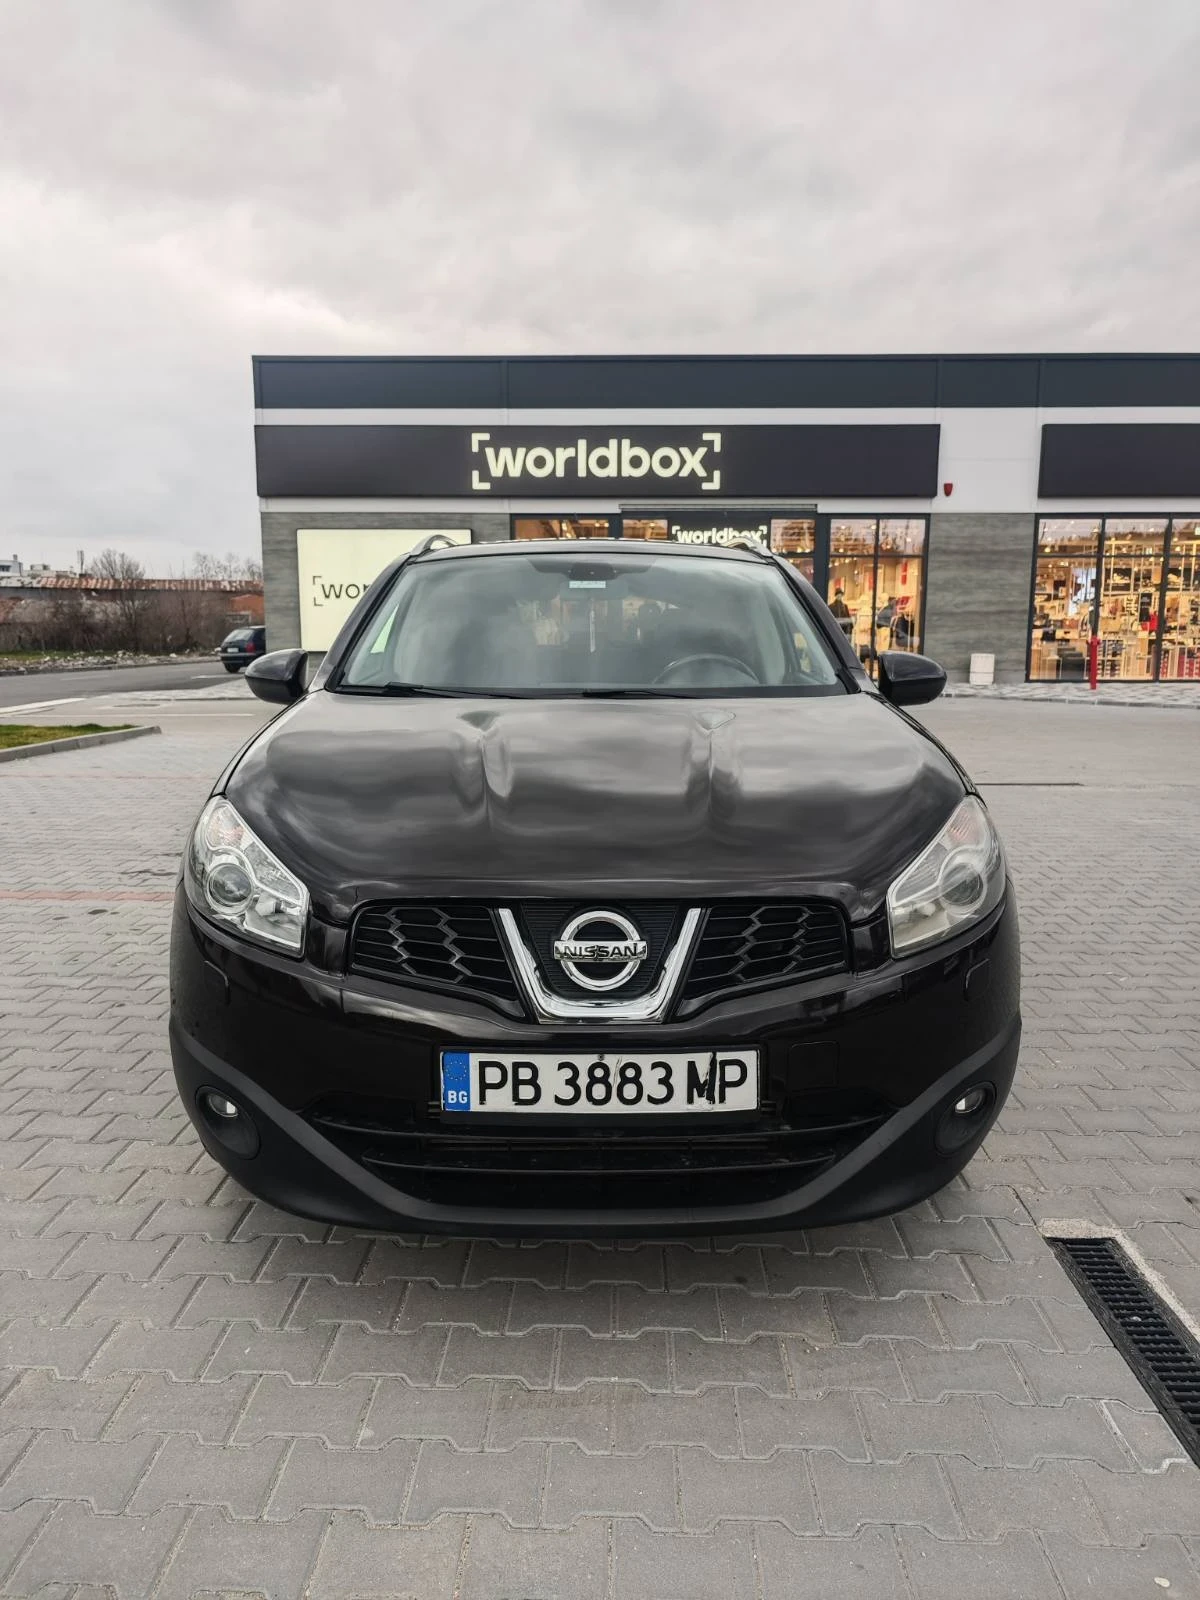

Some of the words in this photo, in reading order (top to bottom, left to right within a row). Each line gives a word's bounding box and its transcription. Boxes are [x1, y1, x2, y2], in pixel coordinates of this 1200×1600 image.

[485, 438, 708, 478] worldbox
[563, 943, 638, 958] NISSAN
[447, 1090, 469, 1104] BG
[478, 1060, 542, 1106] PB
[554, 1060, 675, 1106] 3883
[687, 1057, 748, 1105] MP
